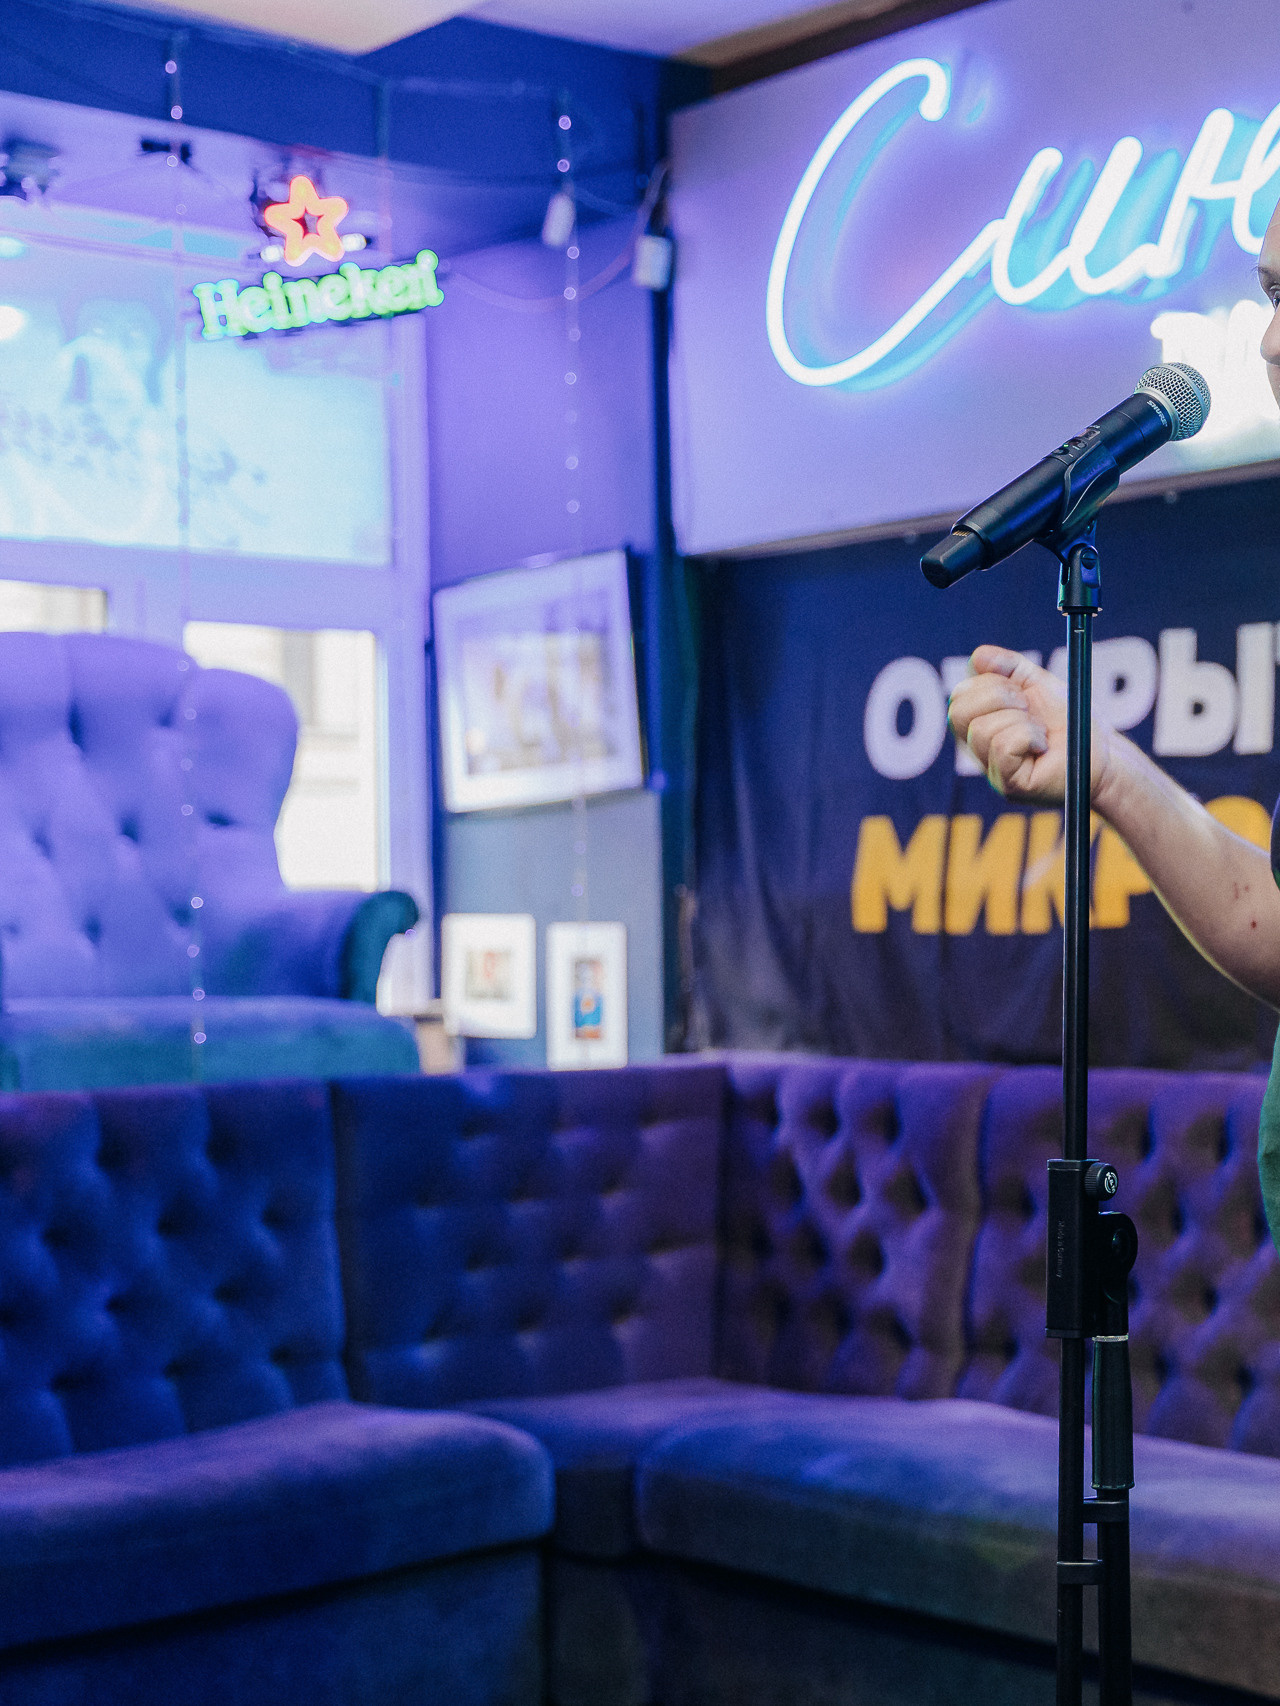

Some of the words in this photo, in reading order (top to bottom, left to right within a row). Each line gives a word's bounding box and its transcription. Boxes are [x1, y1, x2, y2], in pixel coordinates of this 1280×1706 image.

[192, 248, 445, 341] Heineken
[1146, 400, 1168, 427] SHURE
[850, 795, 1272, 936] МИКР
